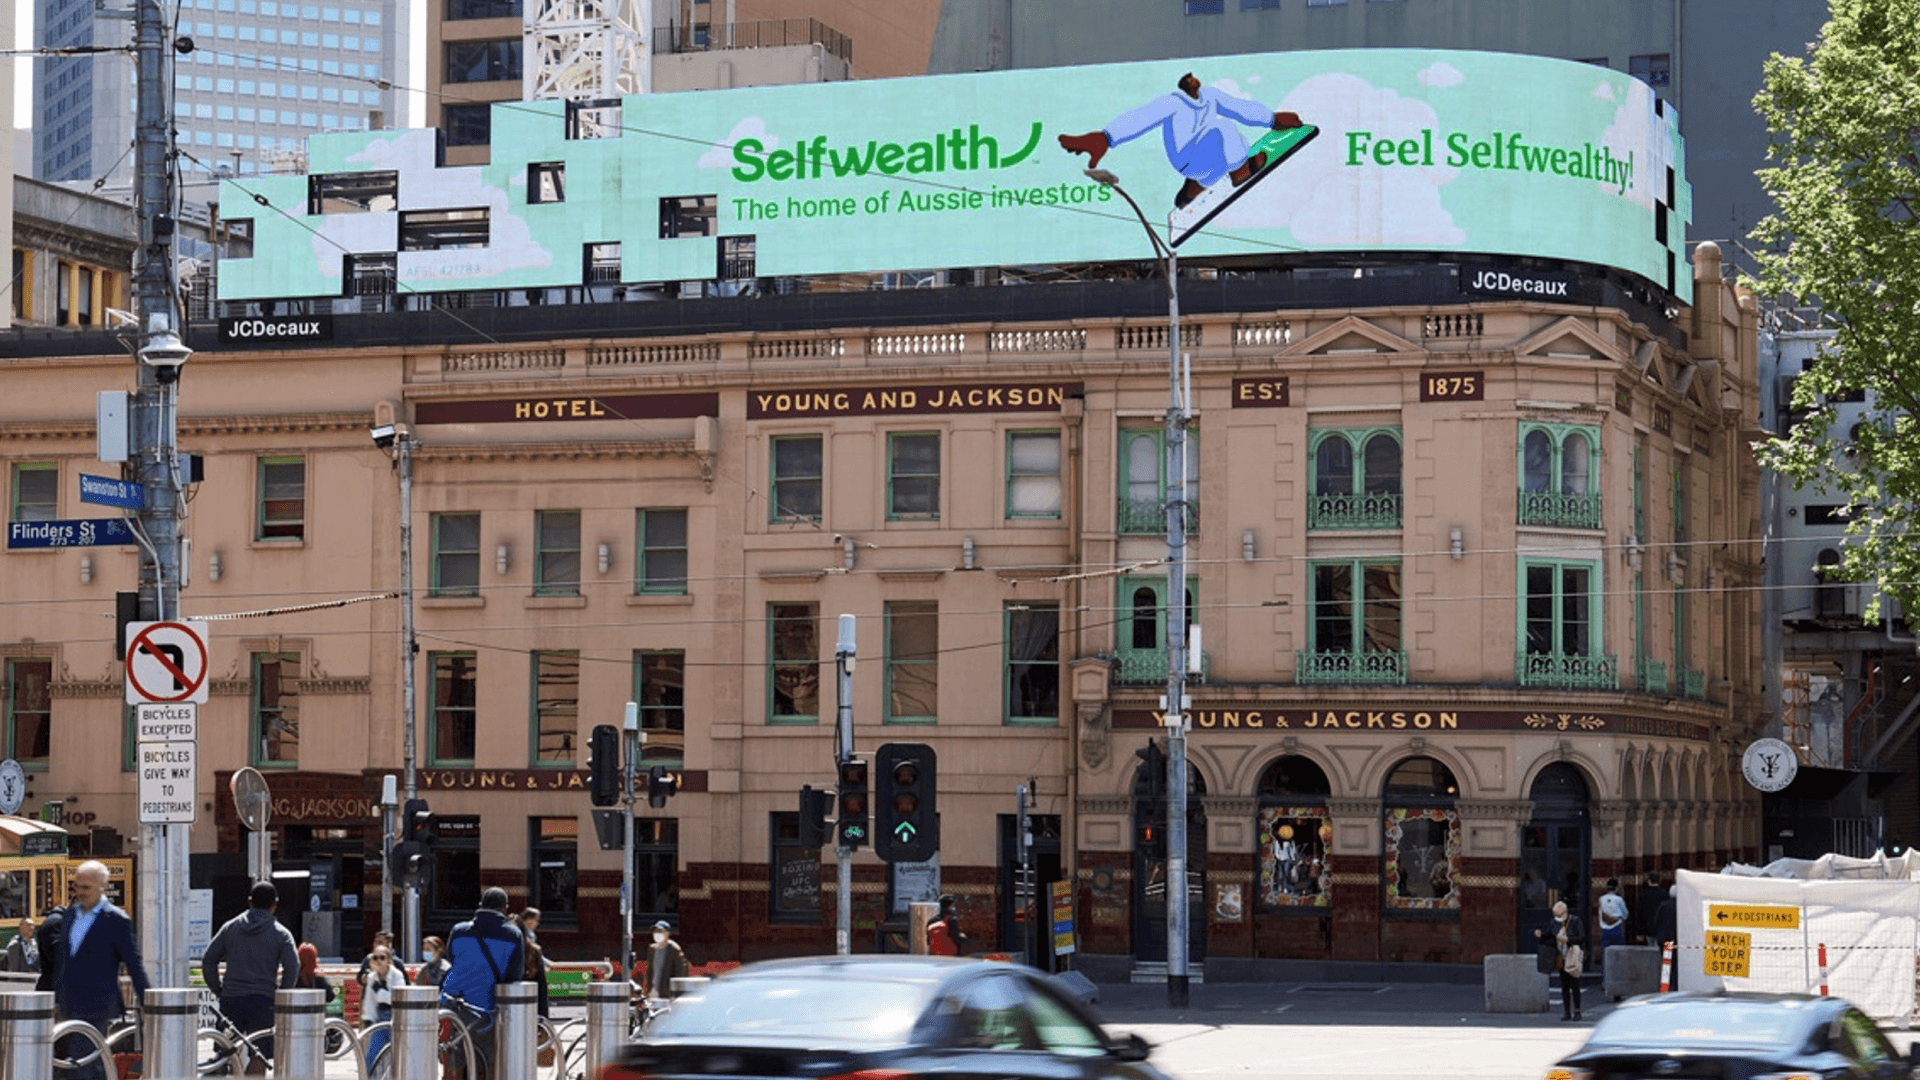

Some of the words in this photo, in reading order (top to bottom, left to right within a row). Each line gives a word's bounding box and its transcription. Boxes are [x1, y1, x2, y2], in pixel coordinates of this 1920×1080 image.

[731, 123, 998, 183] Selfwealth
[1345, 129, 1435, 167] Feel
[1446, 131, 1634, 196] Selfwealthy!
[732, 197, 779, 220] The
[786, 195, 856, 218] home
[864, 189, 890, 214] of
[899, 187, 983, 212] Aussie
[991, 182, 1112, 208] investors
[1472, 271, 1568, 296] JCDecaux
[228, 318, 320, 338] JCDecaux
[1428, 377, 1475, 396] 1875
[757, 393, 850, 412] YOUNG
[862, 390, 917, 409] AND
[928, 387, 1064, 407] JACKSON
[515, 399, 605, 418] HOTEL
[82, 476, 118, 497] Swanston
[118, 482, 128, 498] St
[12, 522, 73, 539] Flinders
[79, 520, 96, 537] St
[142, 709, 191, 720] BICYCLES
[1275, 715, 1289, 728] &
[1304, 711, 1459, 729] JACKSON
[142, 724, 192, 735] EXCEPTED
[144, 751, 190, 763] BICYCLES
[144, 768, 166, 780] GIVE
[171, 768, 191, 779] WAY
[422, 771, 516, 788] YOUNG
[527, 776, 538, 788] &
[162, 785, 174, 796] TO
[143, 801, 192, 814] PEDESTRIANS
[297, 798, 372, 819] JACKSON
[60, 811, 97, 825] HOP
[1732, 911, 1793, 923] PEDESTRIANS
[1711, 934, 1746, 947] WATCH
[1712, 947, 1745, 960] YOUR
[1711, 960, 1742, 973] STEP
